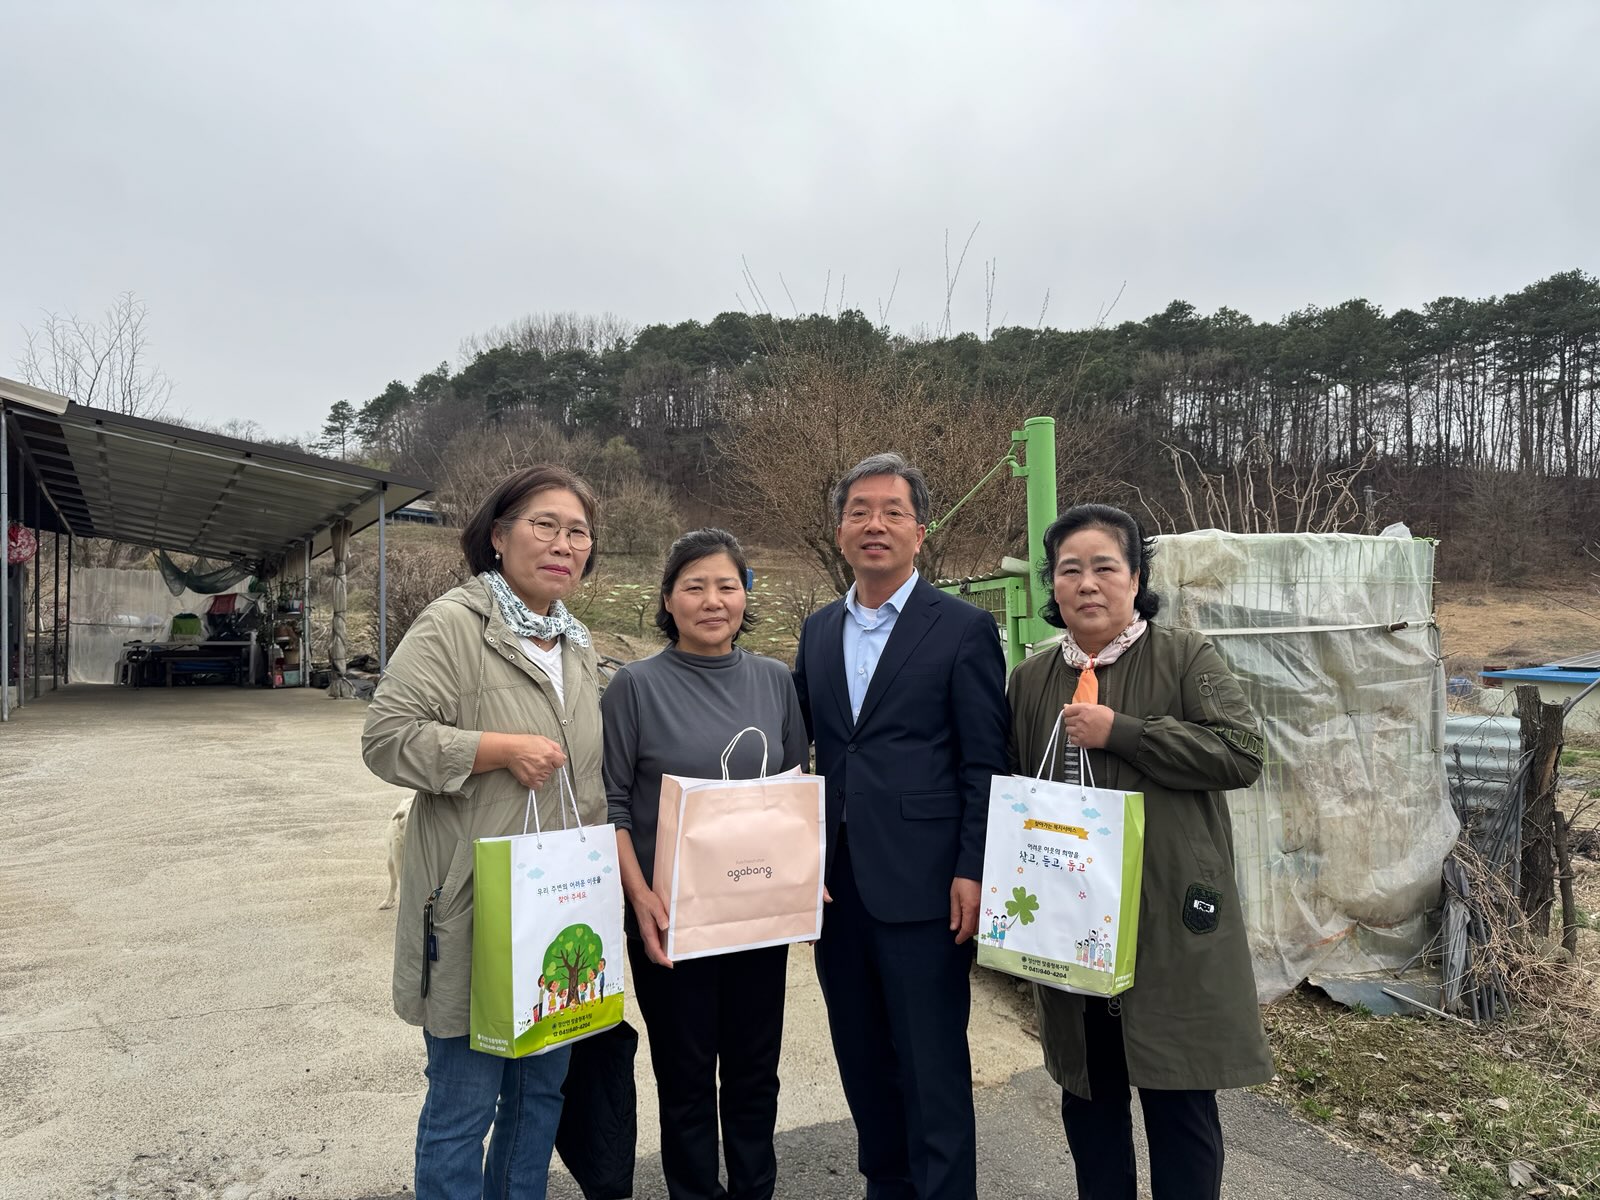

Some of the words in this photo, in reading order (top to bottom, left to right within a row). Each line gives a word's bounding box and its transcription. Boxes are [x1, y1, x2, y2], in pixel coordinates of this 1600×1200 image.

[1035, 821, 1052, 829] 찾아가는
[1053, 824, 1077, 833] 복지서비스
[1027, 843, 1042, 852] 어려운
[1044, 846, 1061, 855] 이웃의
[1062, 849, 1079, 859] 희망을
[1020, 850, 1038, 865] 찾고,
[1042, 855, 1063, 870] 듣고,
[1067, 859, 1086, 872] 돕고
[727, 866, 773, 882] agabang
[537, 887, 549, 896] 우리
[551, 883, 568, 893] 주변의
[569, 879, 585, 889] 어려운
[587, 876, 601, 885] 이웃을
[558, 894, 569, 903] 찾아
[571, 891, 587, 900] 주세요
